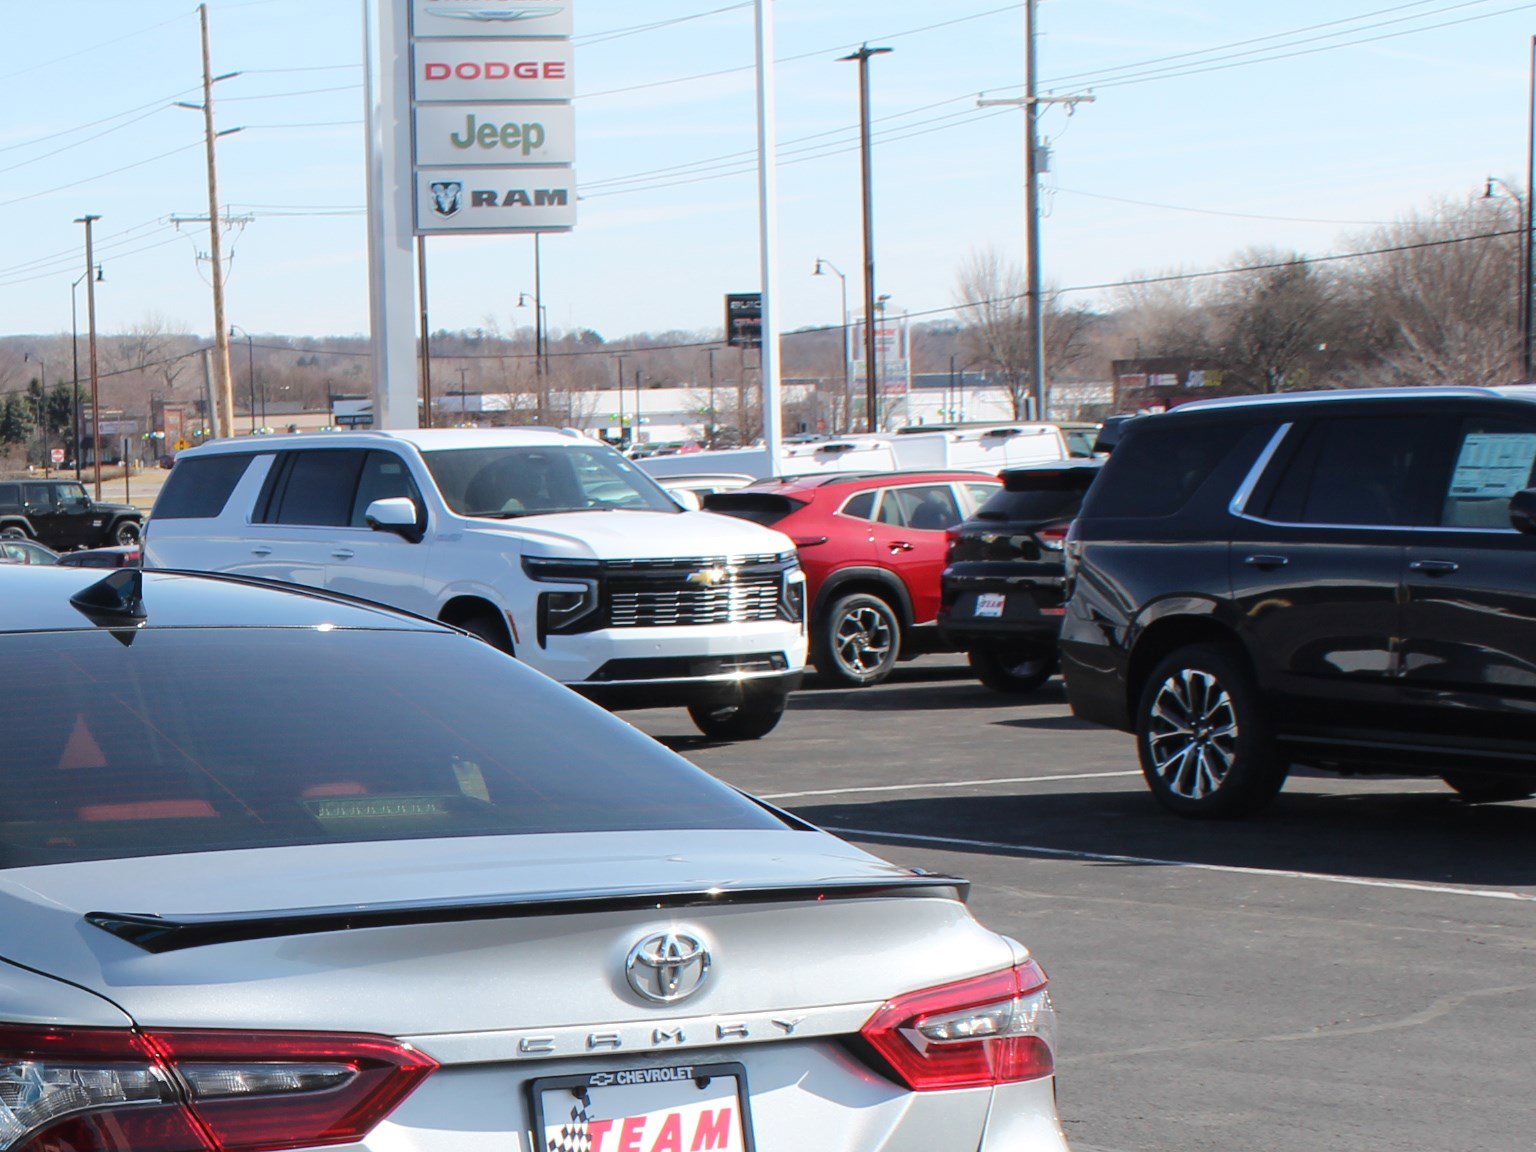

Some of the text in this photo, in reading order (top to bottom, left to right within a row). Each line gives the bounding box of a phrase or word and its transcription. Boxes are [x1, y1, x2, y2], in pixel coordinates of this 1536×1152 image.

[424, 61, 566, 80] DODGE
[450, 113, 545, 156] Jeep
[471, 188, 568, 207] RAM
[730, 300, 761, 309] BUIC
[516, 1014, 807, 1052] CAMRY
[615, 1065, 694, 1086] CHEVROLET
